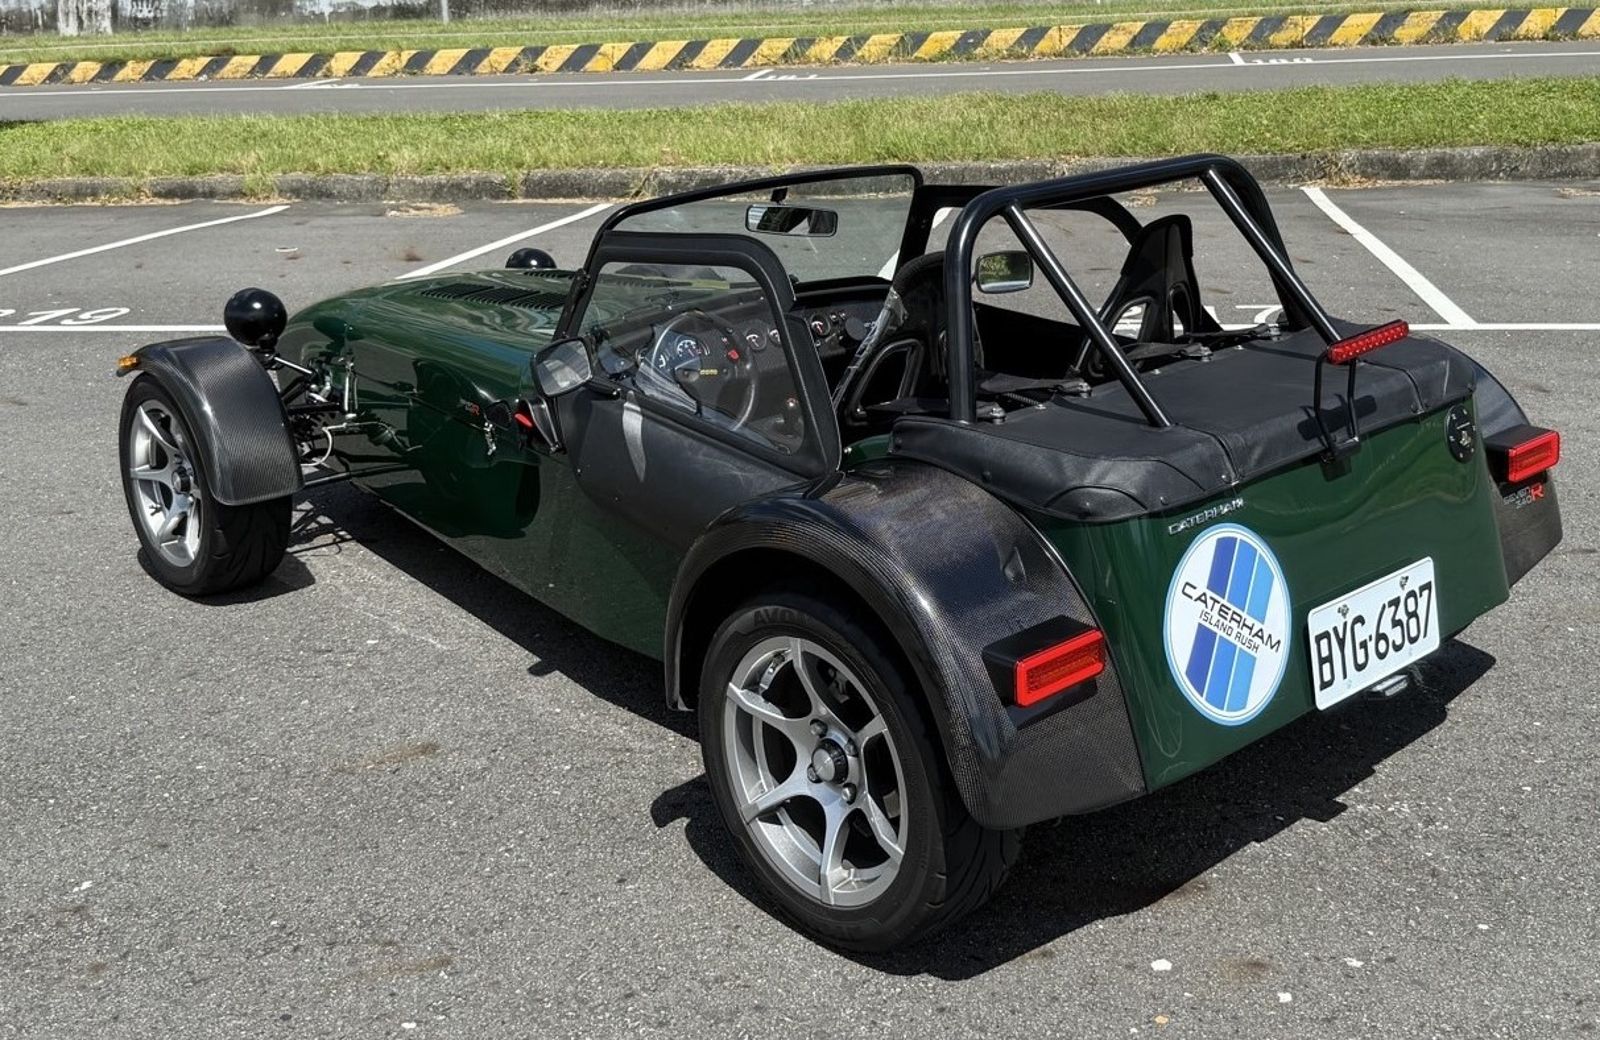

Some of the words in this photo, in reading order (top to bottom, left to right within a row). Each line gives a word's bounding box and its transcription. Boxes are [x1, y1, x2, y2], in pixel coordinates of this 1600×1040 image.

[1168, 497, 1244, 535] CATERHAM
[1181, 581, 1281, 653] CATERHAM
[1199, 609, 1234, 637] ISLAND
[1234, 631, 1260, 653] RUSH
[1314, 580, 1432, 691] BYG-6387
